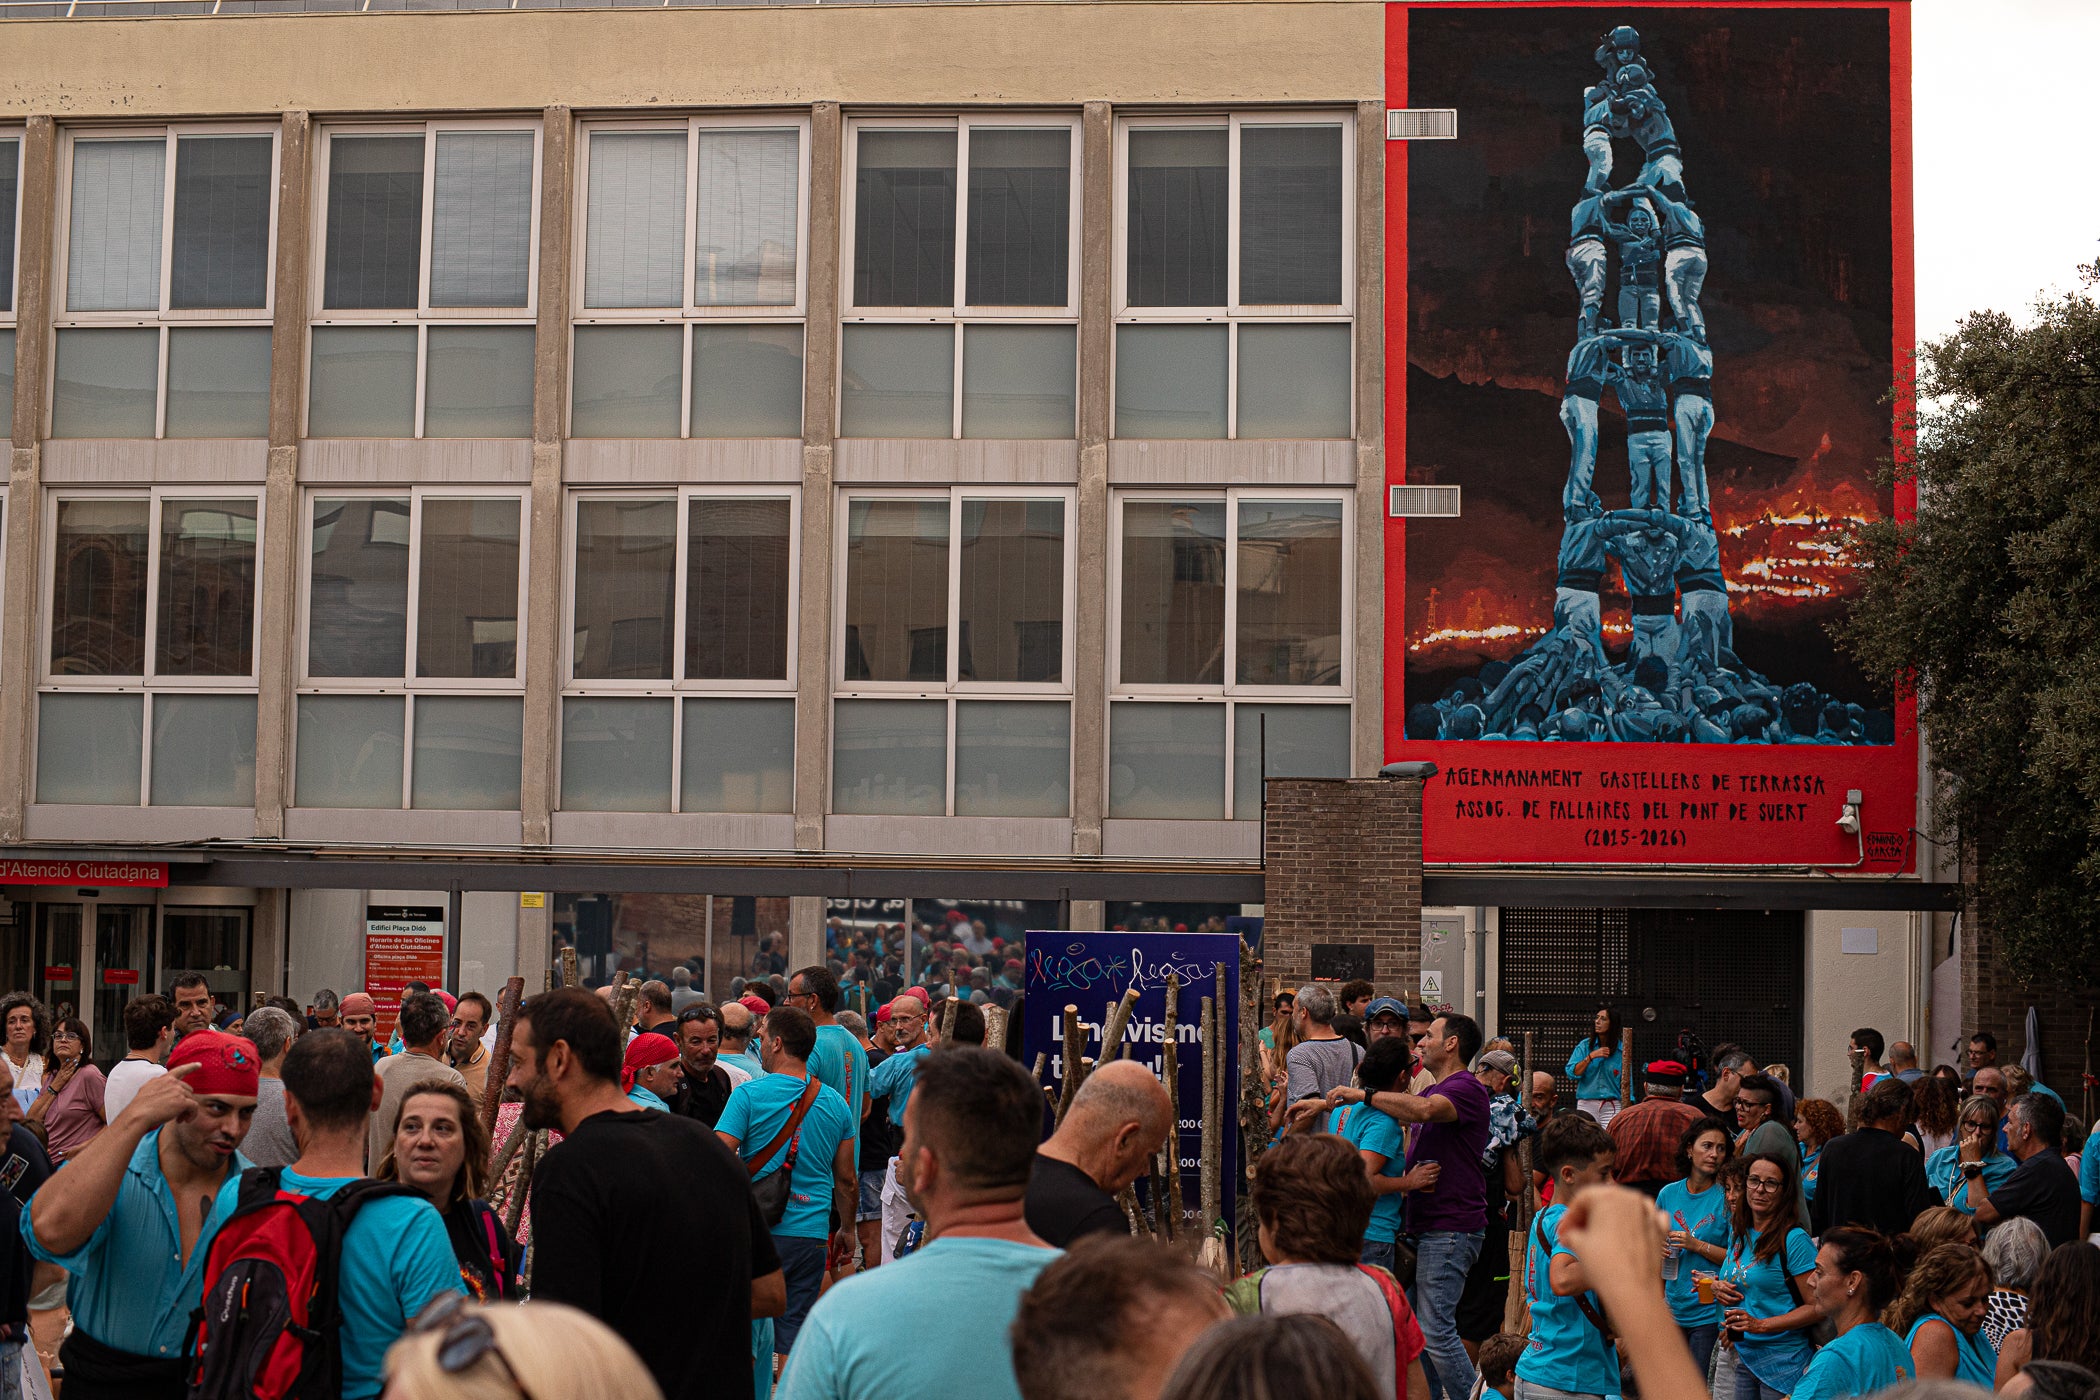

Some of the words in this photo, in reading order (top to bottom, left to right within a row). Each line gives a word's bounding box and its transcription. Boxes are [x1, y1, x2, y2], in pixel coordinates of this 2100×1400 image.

[1445, 767, 1583, 788] AGERMANAMENT
[1600, 771, 1701, 790] CASTELLERS
[1712, 774, 1731, 791] DE
[1739, 775, 1826, 795] TERRASSA
[1455, 799, 1511, 819] ASSOC.
[1522, 800, 1541, 819] DE
[1642, 801, 1669, 820] DEL
[1680, 802, 1719, 821] PONT
[1729, 802, 1748, 821] DE
[1759, 802, 1808, 822] SUERT
[1584, 828, 1687, 847] (2015-2026)
[0, 862, 72, 878] d'Atenció
[76, 862, 161, 880] Ciutadana
